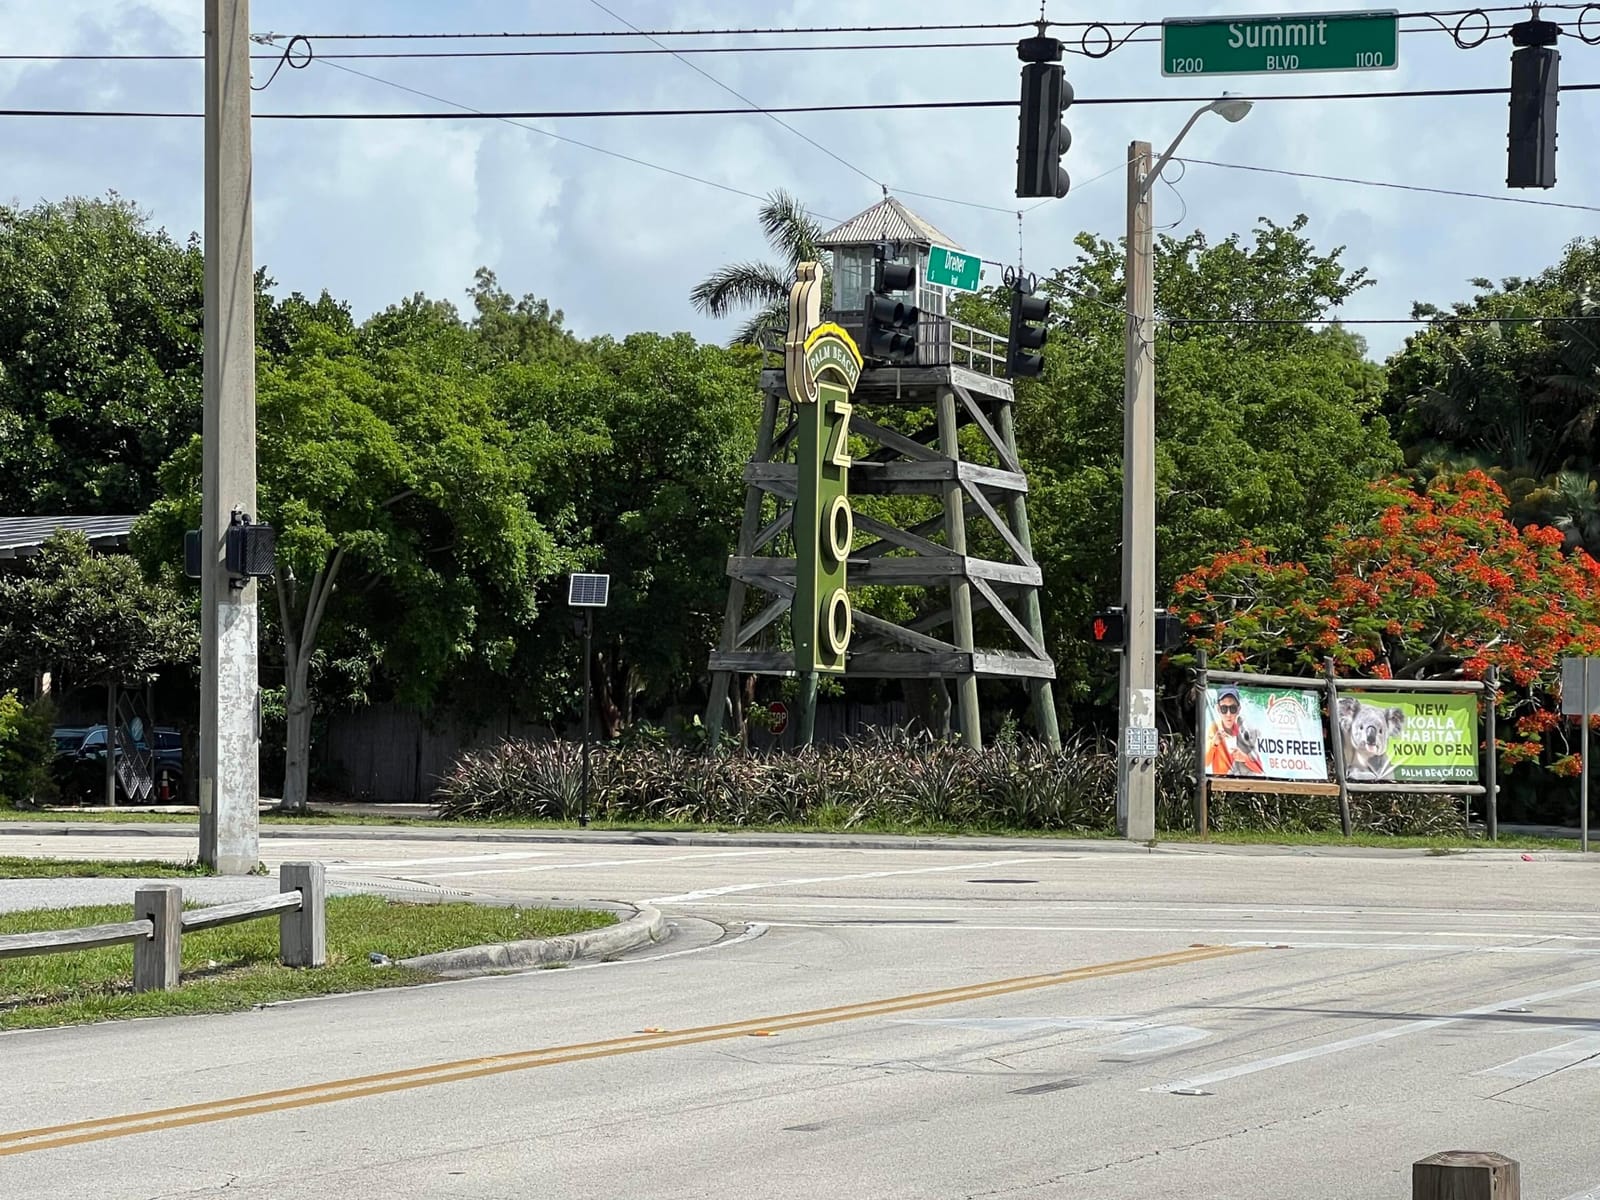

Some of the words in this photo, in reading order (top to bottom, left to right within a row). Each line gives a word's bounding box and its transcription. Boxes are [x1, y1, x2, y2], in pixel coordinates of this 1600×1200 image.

[1228, 19, 1327, 48] Summit
[1172, 58, 1203, 73] 1200
[1266, 54, 1299, 70] BLVD
[1356, 52, 1383, 67] 1100
[810, 345, 830, 371] PALM
[832, 346, 856, 383] BEACH
[828, 400, 853, 655] ZOO
[1415, 703, 1448, 716] NEW
[1407, 717, 1455, 729] KOALA
[1401, 730, 1463, 743] HABITAT
[1257, 738, 1284, 754] KIDS
[1286, 739, 1322, 756] FREE!
[1394, 744, 1427, 756] NOW
[1433, 744, 1473, 756] OPEN
[1269, 757, 1280, 769] BE
[1282, 758, 1312, 771] COOL.
[1401, 768, 1421, 777] PALM
[1424, 768, 1454, 777] BEACH
[1455, 768, 1473, 777] ZOO
